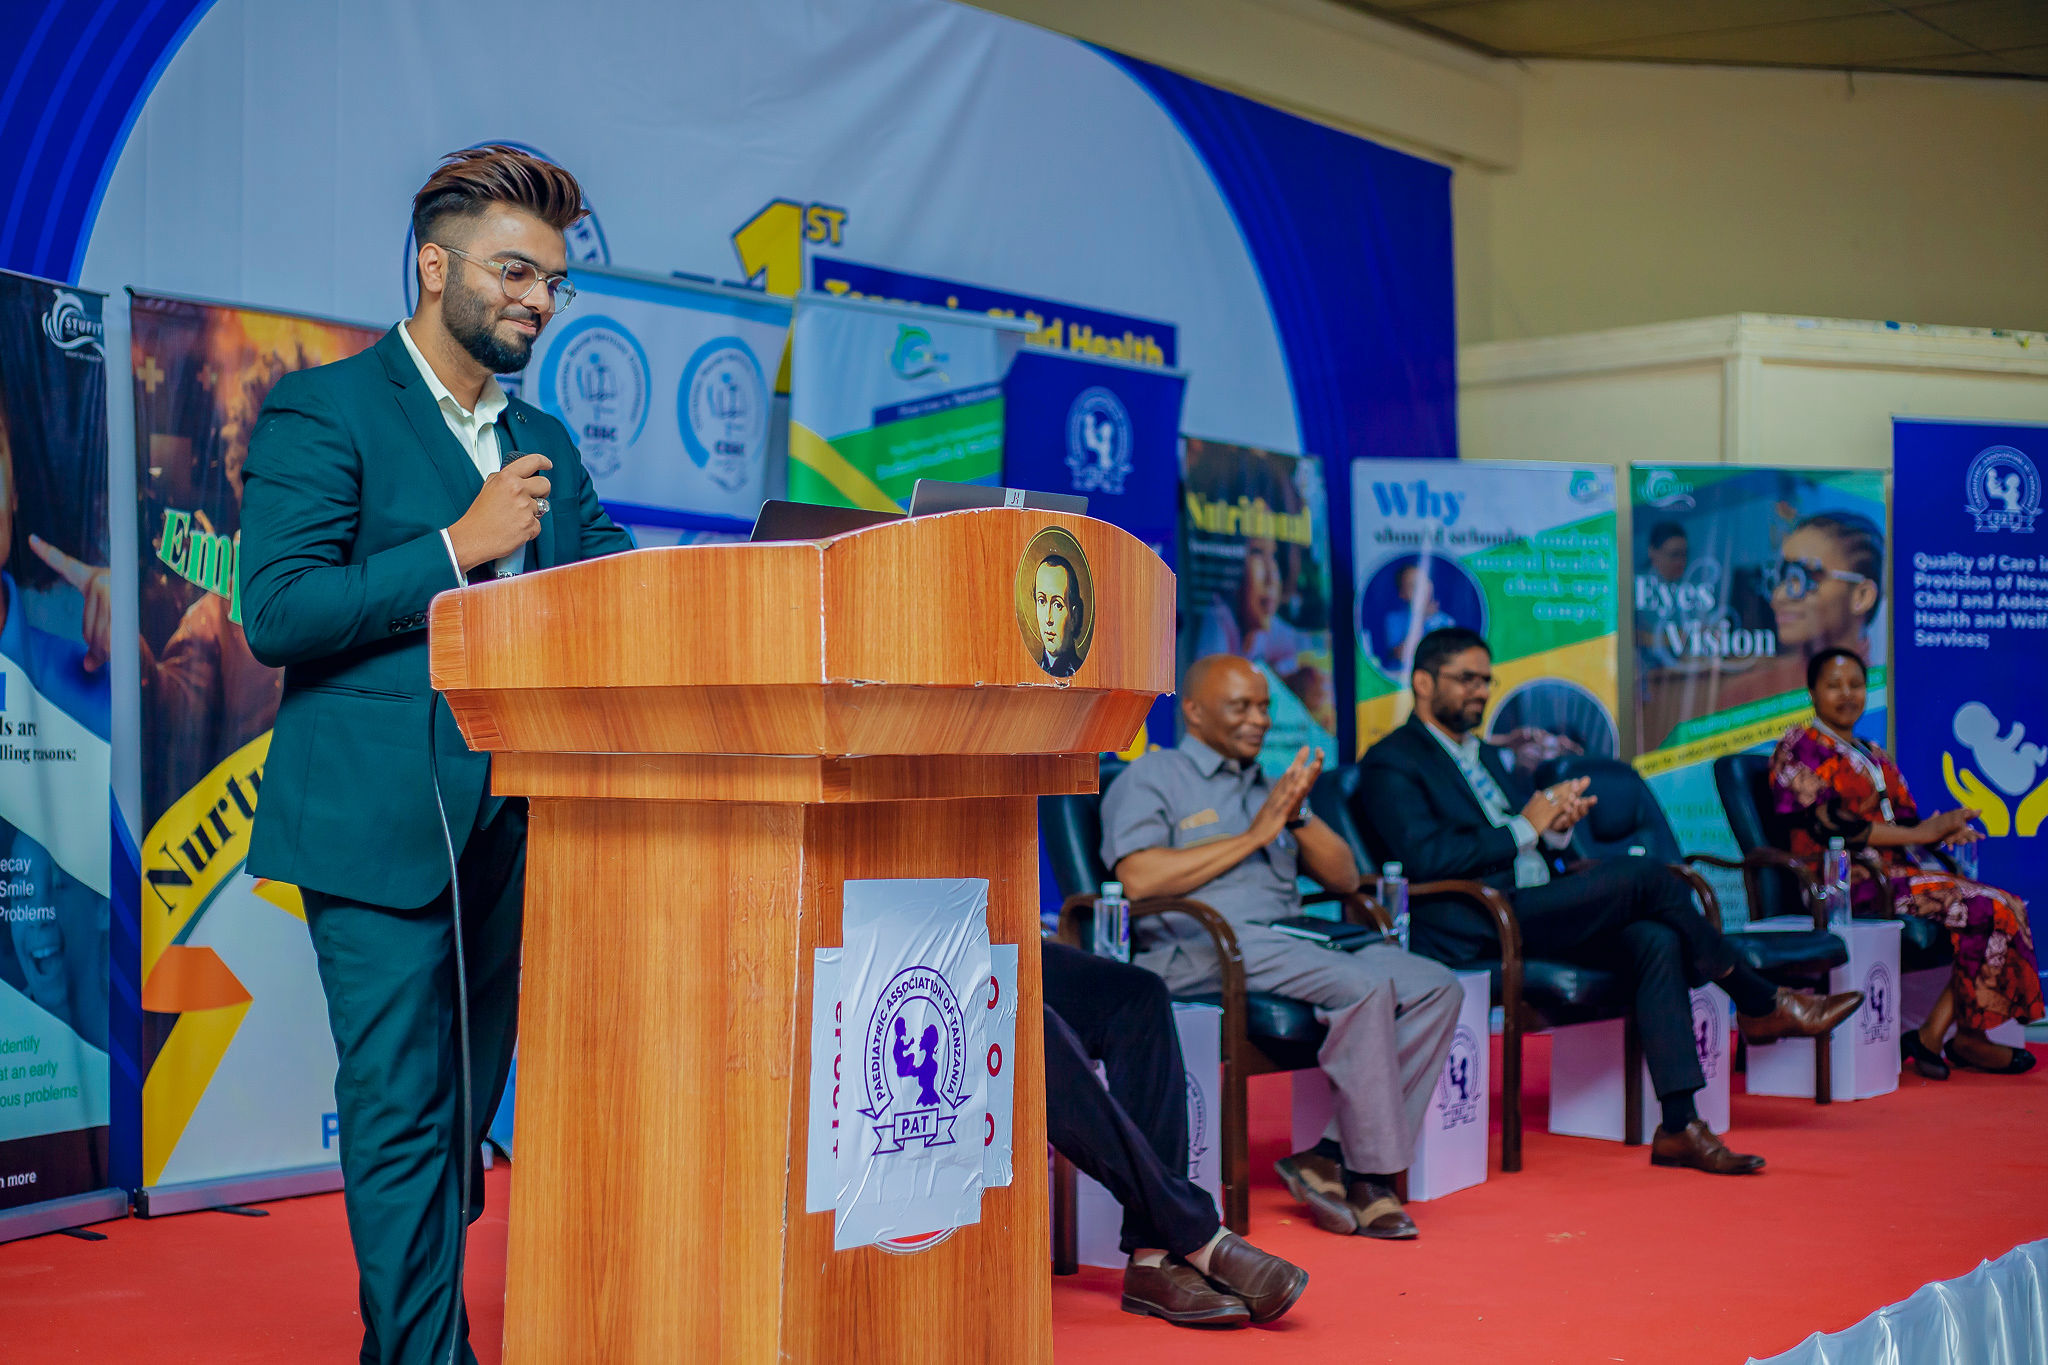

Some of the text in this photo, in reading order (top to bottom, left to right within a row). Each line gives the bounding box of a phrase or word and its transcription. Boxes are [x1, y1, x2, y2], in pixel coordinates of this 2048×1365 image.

[1372, 479, 1465, 526] Why
[1373, 525, 1445, 545] shoud
[1913, 552, 1974, 574] Quality
[1977, 554, 1996, 571] of
[1998, 555, 2036, 571] Care
[1914, 571, 1992, 590] Provision
[1995, 573, 2013, 590] of
[1634, 574, 1716, 617] Eyes
[1913, 590, 1958, 609] Child
[1961, 592, 1994, 610] and
[1914, 610, 1970, 628] Health
[1974, 611, 2007, 629] and
[1664, 619, 1777, 658] Vision
[871, 976, 961, 1102] PAEDIATRIC ASSOCIATION OF TANZANIA
[11, 1065, 26, 1080] an
[29, 1060, 58, 1079] early
[24, 1085, 78, 1107] problems
[901, 1115, 930, 1135] PAT
[7, 1171, 37, 1188] more
